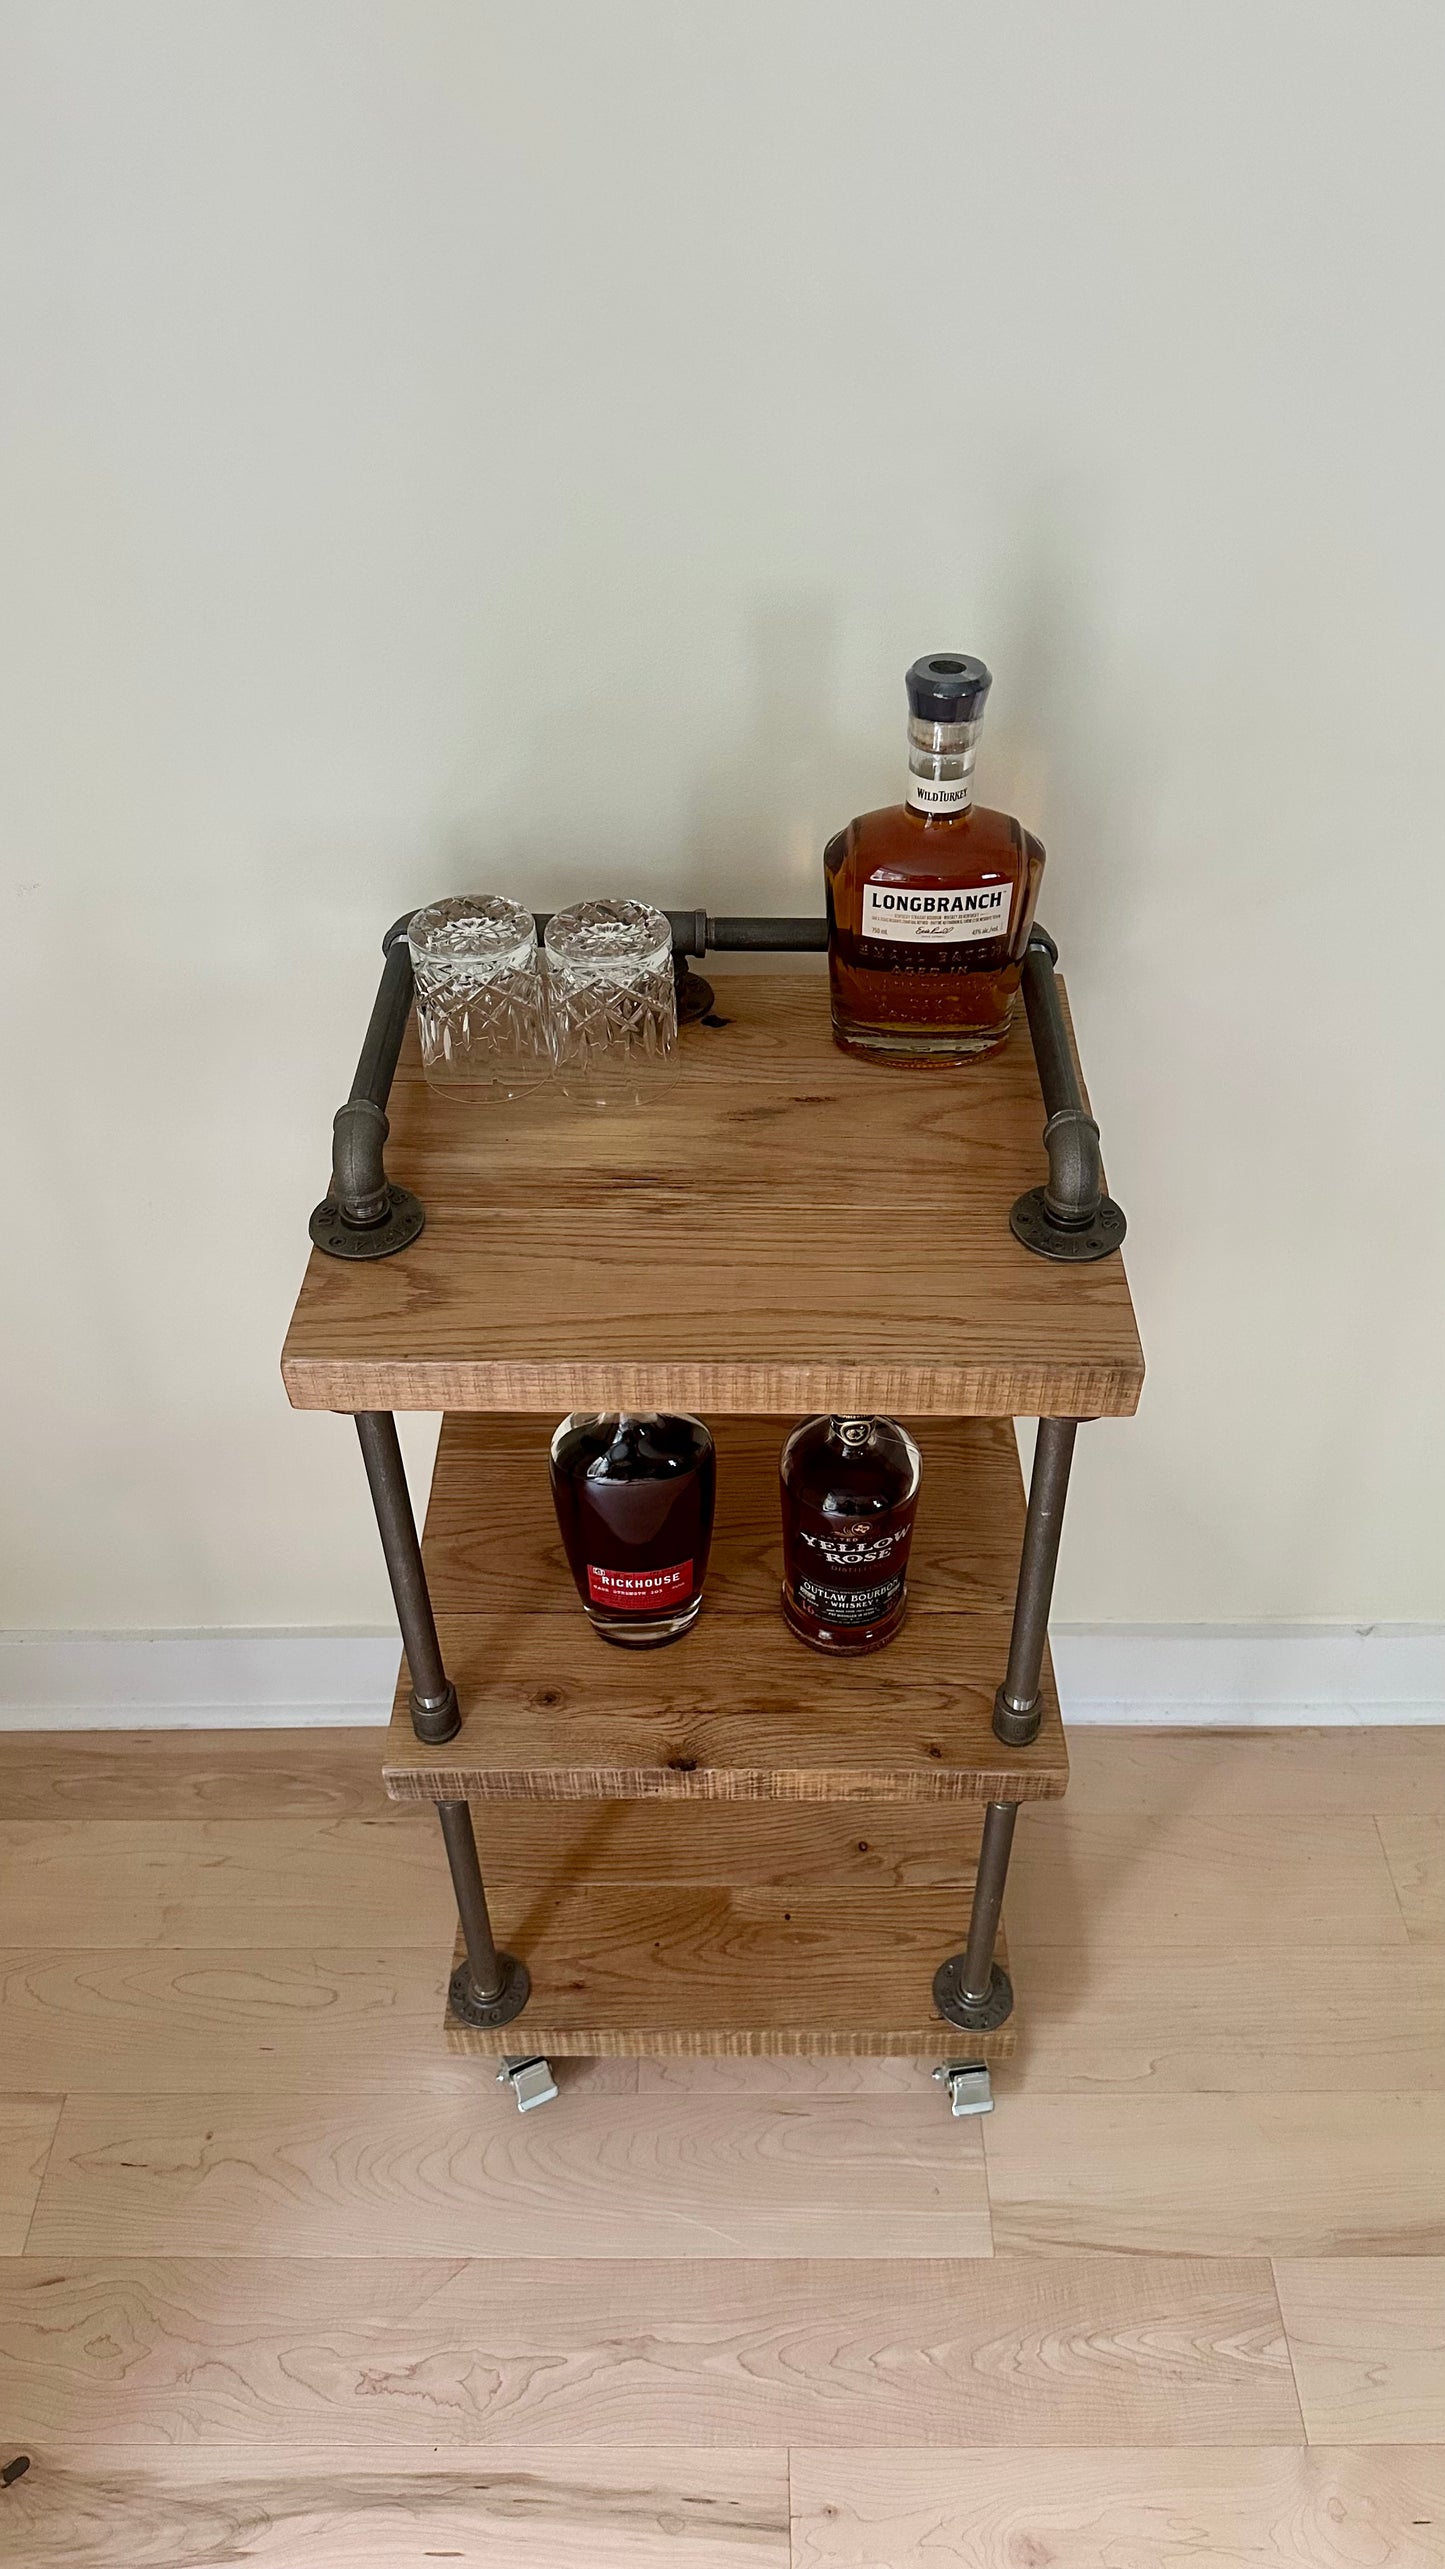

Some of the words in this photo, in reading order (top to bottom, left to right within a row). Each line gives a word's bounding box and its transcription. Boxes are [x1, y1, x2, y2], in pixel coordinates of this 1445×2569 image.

[872, 891, 1002, 913] LONGBRANCH
[800, 1523, 911, 1553] YELLOW
[823, 1547, 892, 1565] ROSE
[601, 1572, 680, 1589] RICKHOUSE
[803, 1581, 847, 1602] OUTLAW
[851, 1577, 898, 1602] BOURBON
[830, 1600, 874, 1609] WHISKEY
